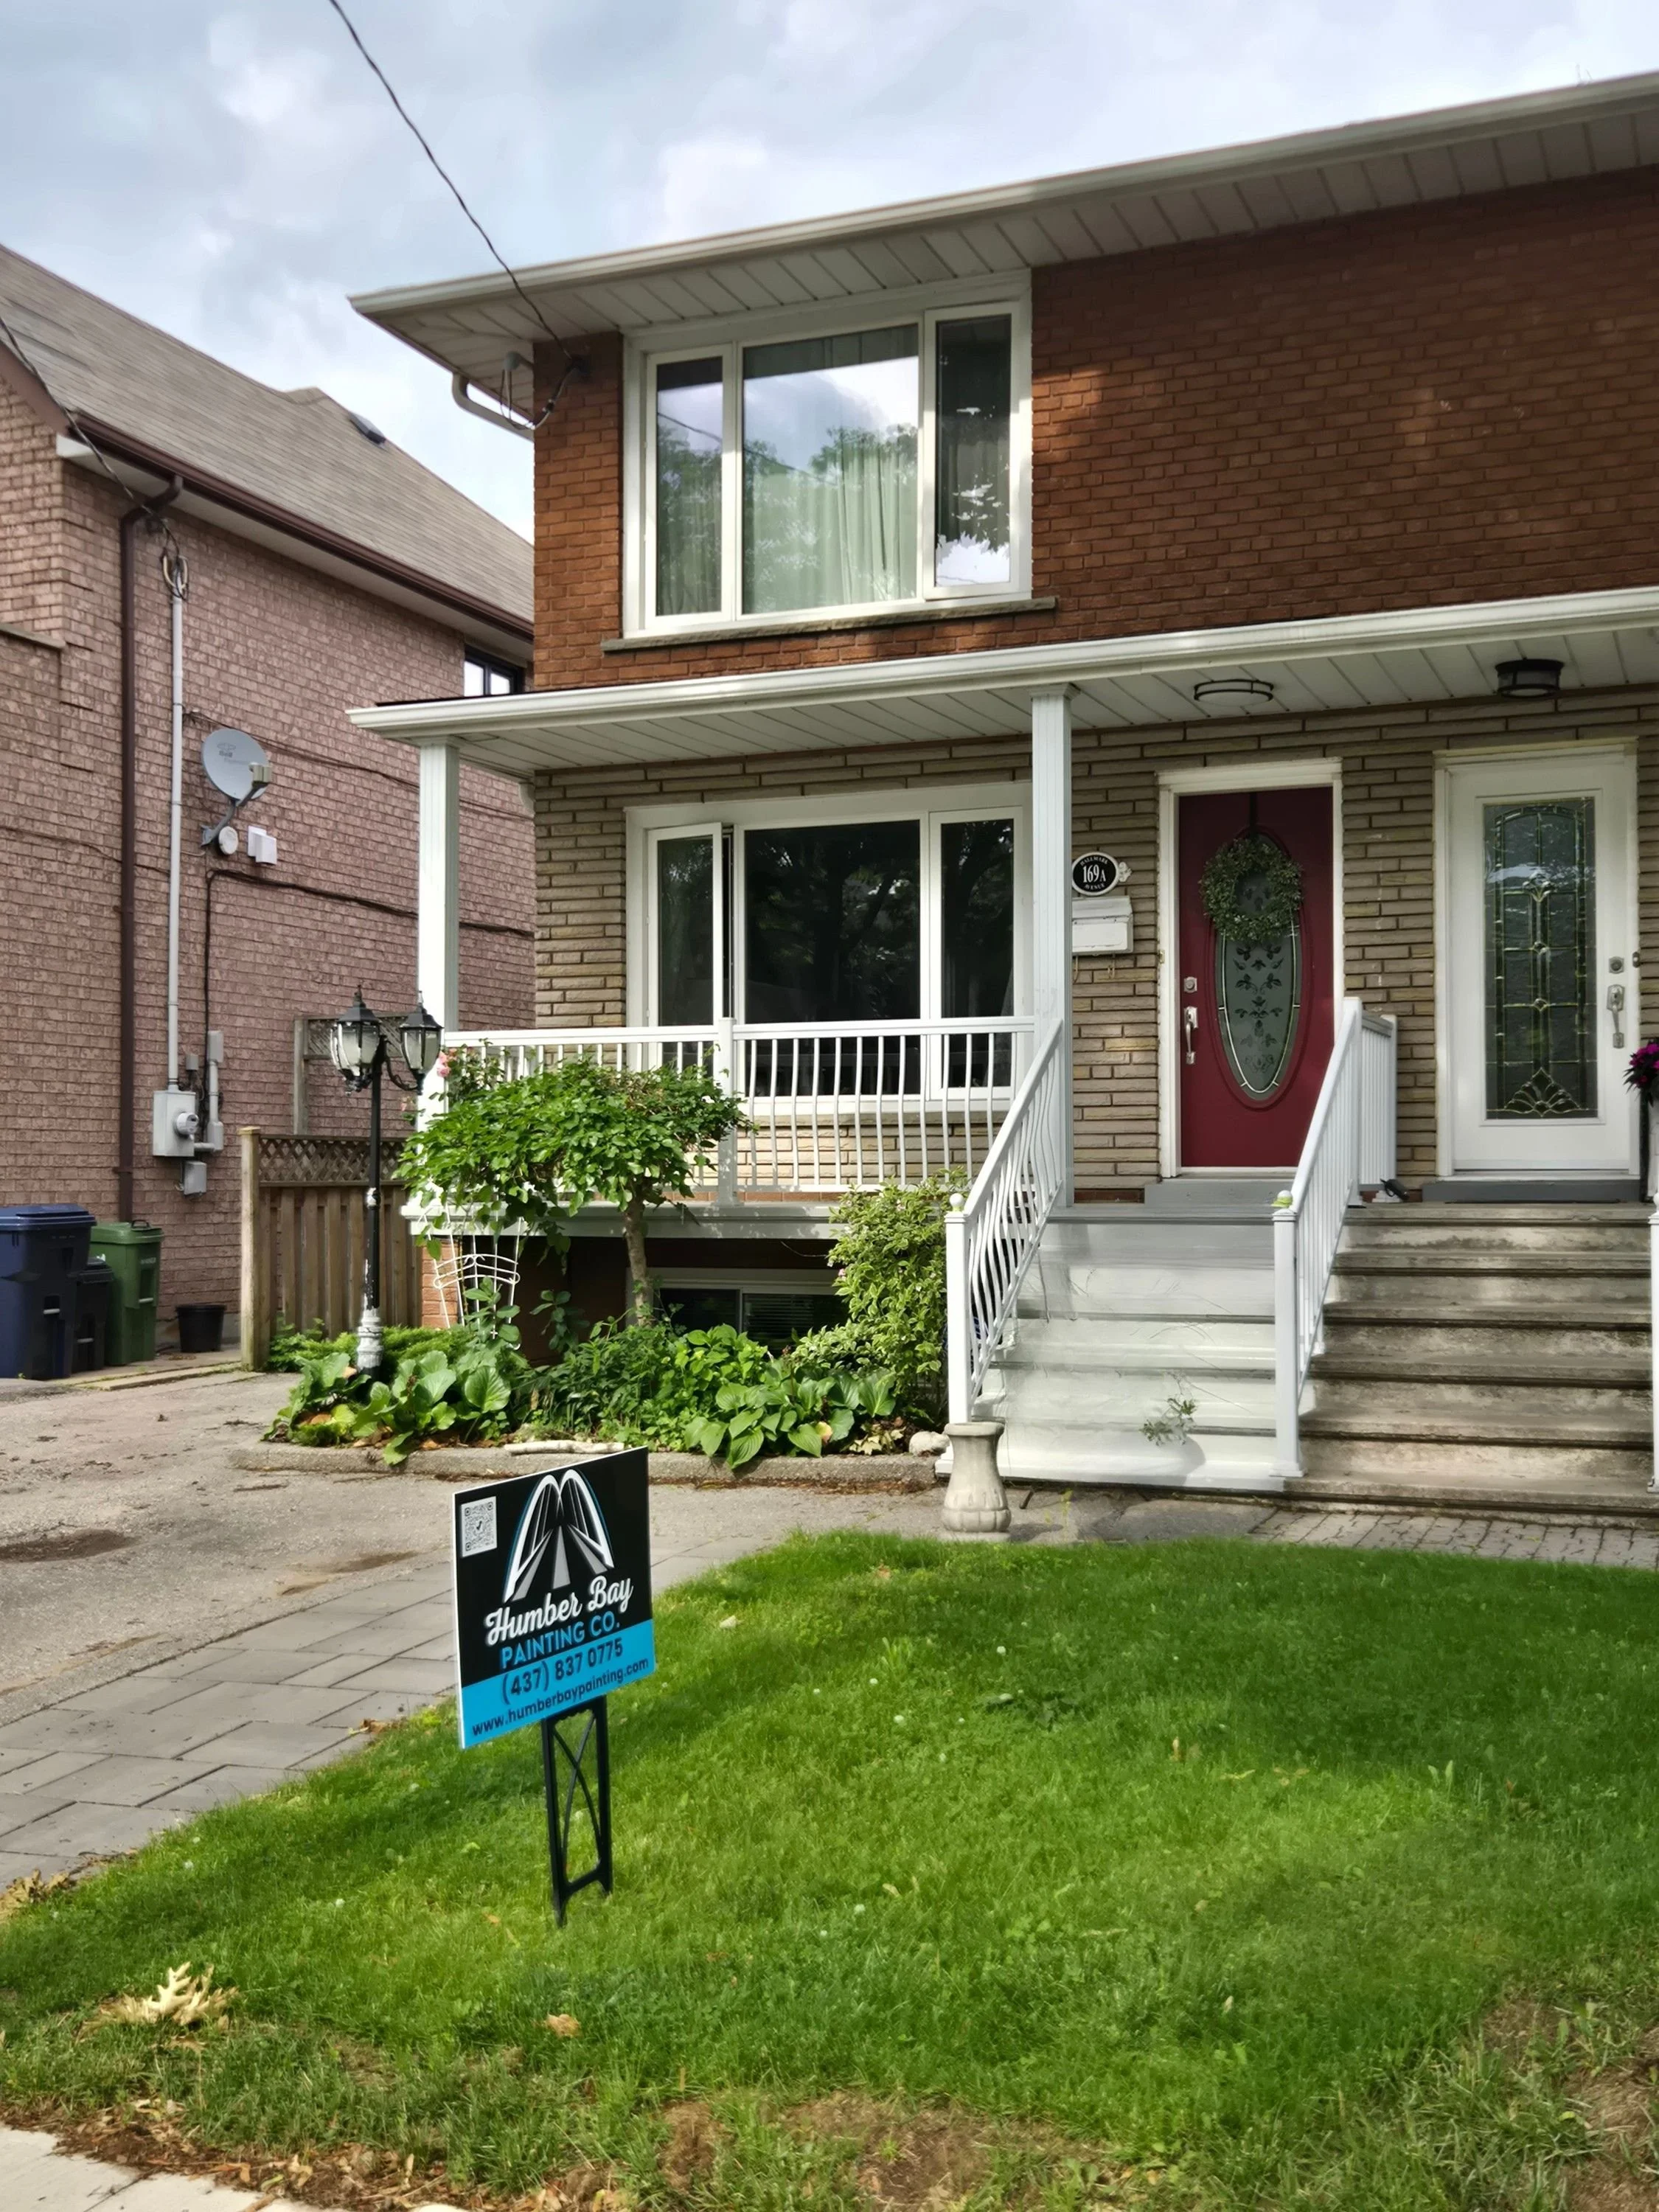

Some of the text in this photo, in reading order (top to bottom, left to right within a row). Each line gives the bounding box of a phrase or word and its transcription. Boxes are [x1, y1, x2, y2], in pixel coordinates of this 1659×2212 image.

[484, 1575, 633, 1646] Humber Bay
[501, 1611, 620, 1669] PAINTING CO.
[472, 1658, 649, 1736] www.humberbaypainting.com
[502, 1637, 623, 1705] (437) 837 0775
